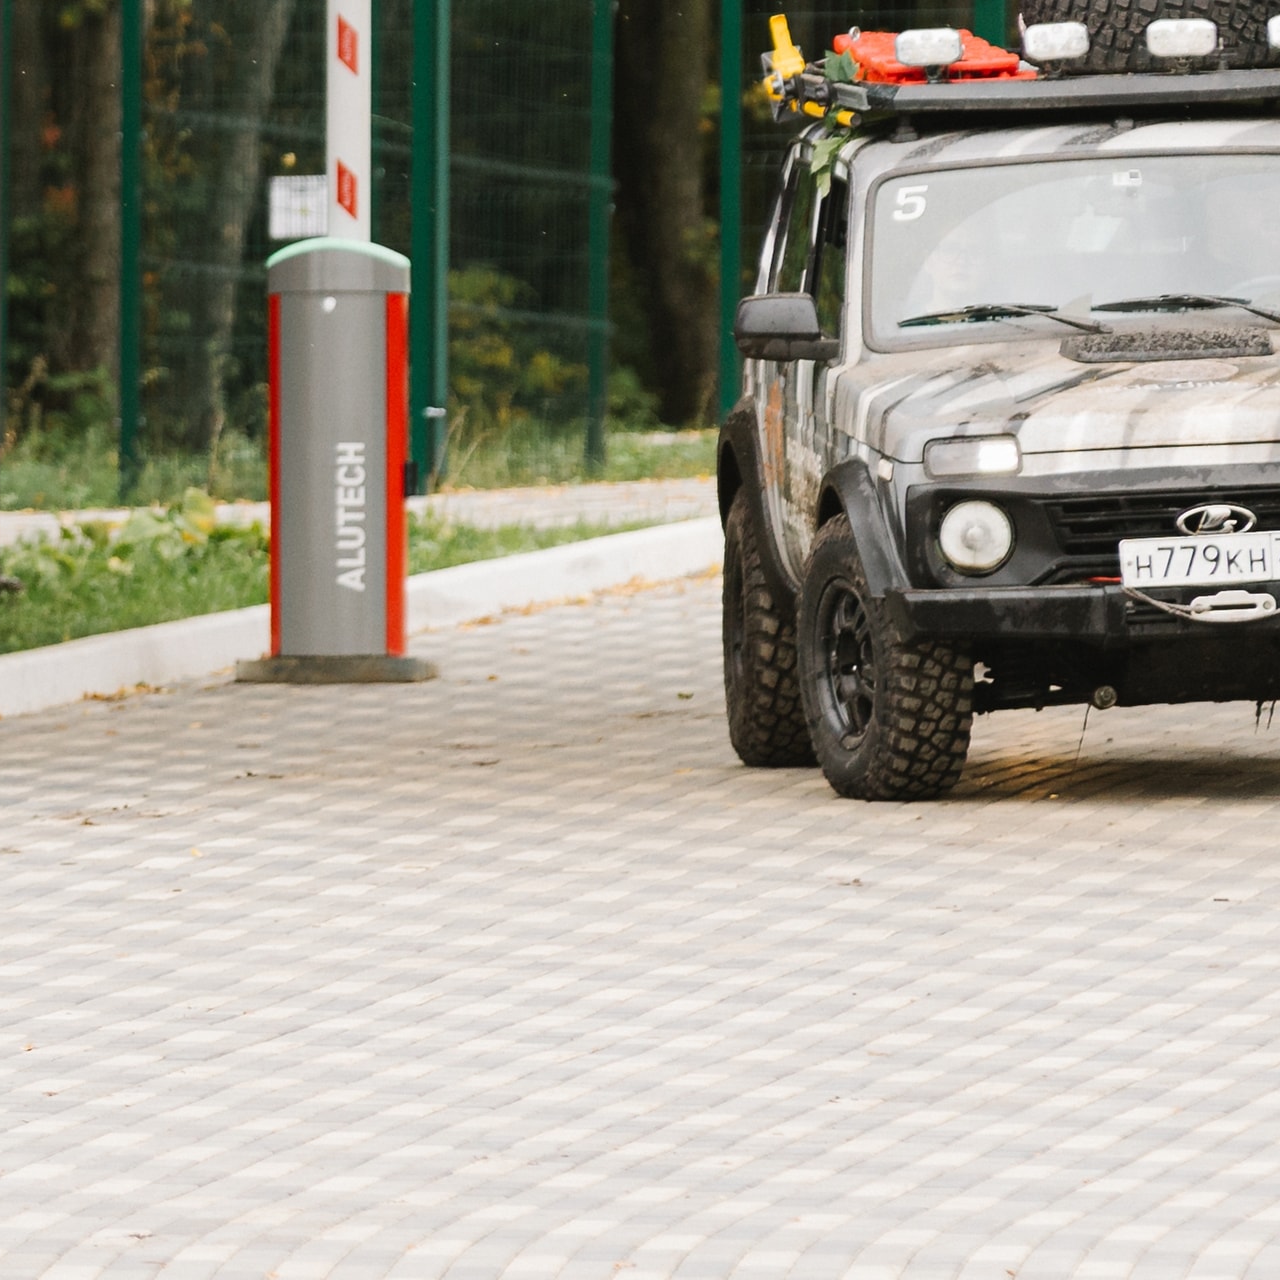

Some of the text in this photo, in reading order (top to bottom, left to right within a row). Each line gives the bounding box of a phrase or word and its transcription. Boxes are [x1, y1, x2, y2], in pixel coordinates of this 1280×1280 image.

[893, 185, 928, 221] 5
[335, 441, 366, 593] ALUTECH
[1135, 544, 1267, 578] Н779КН
